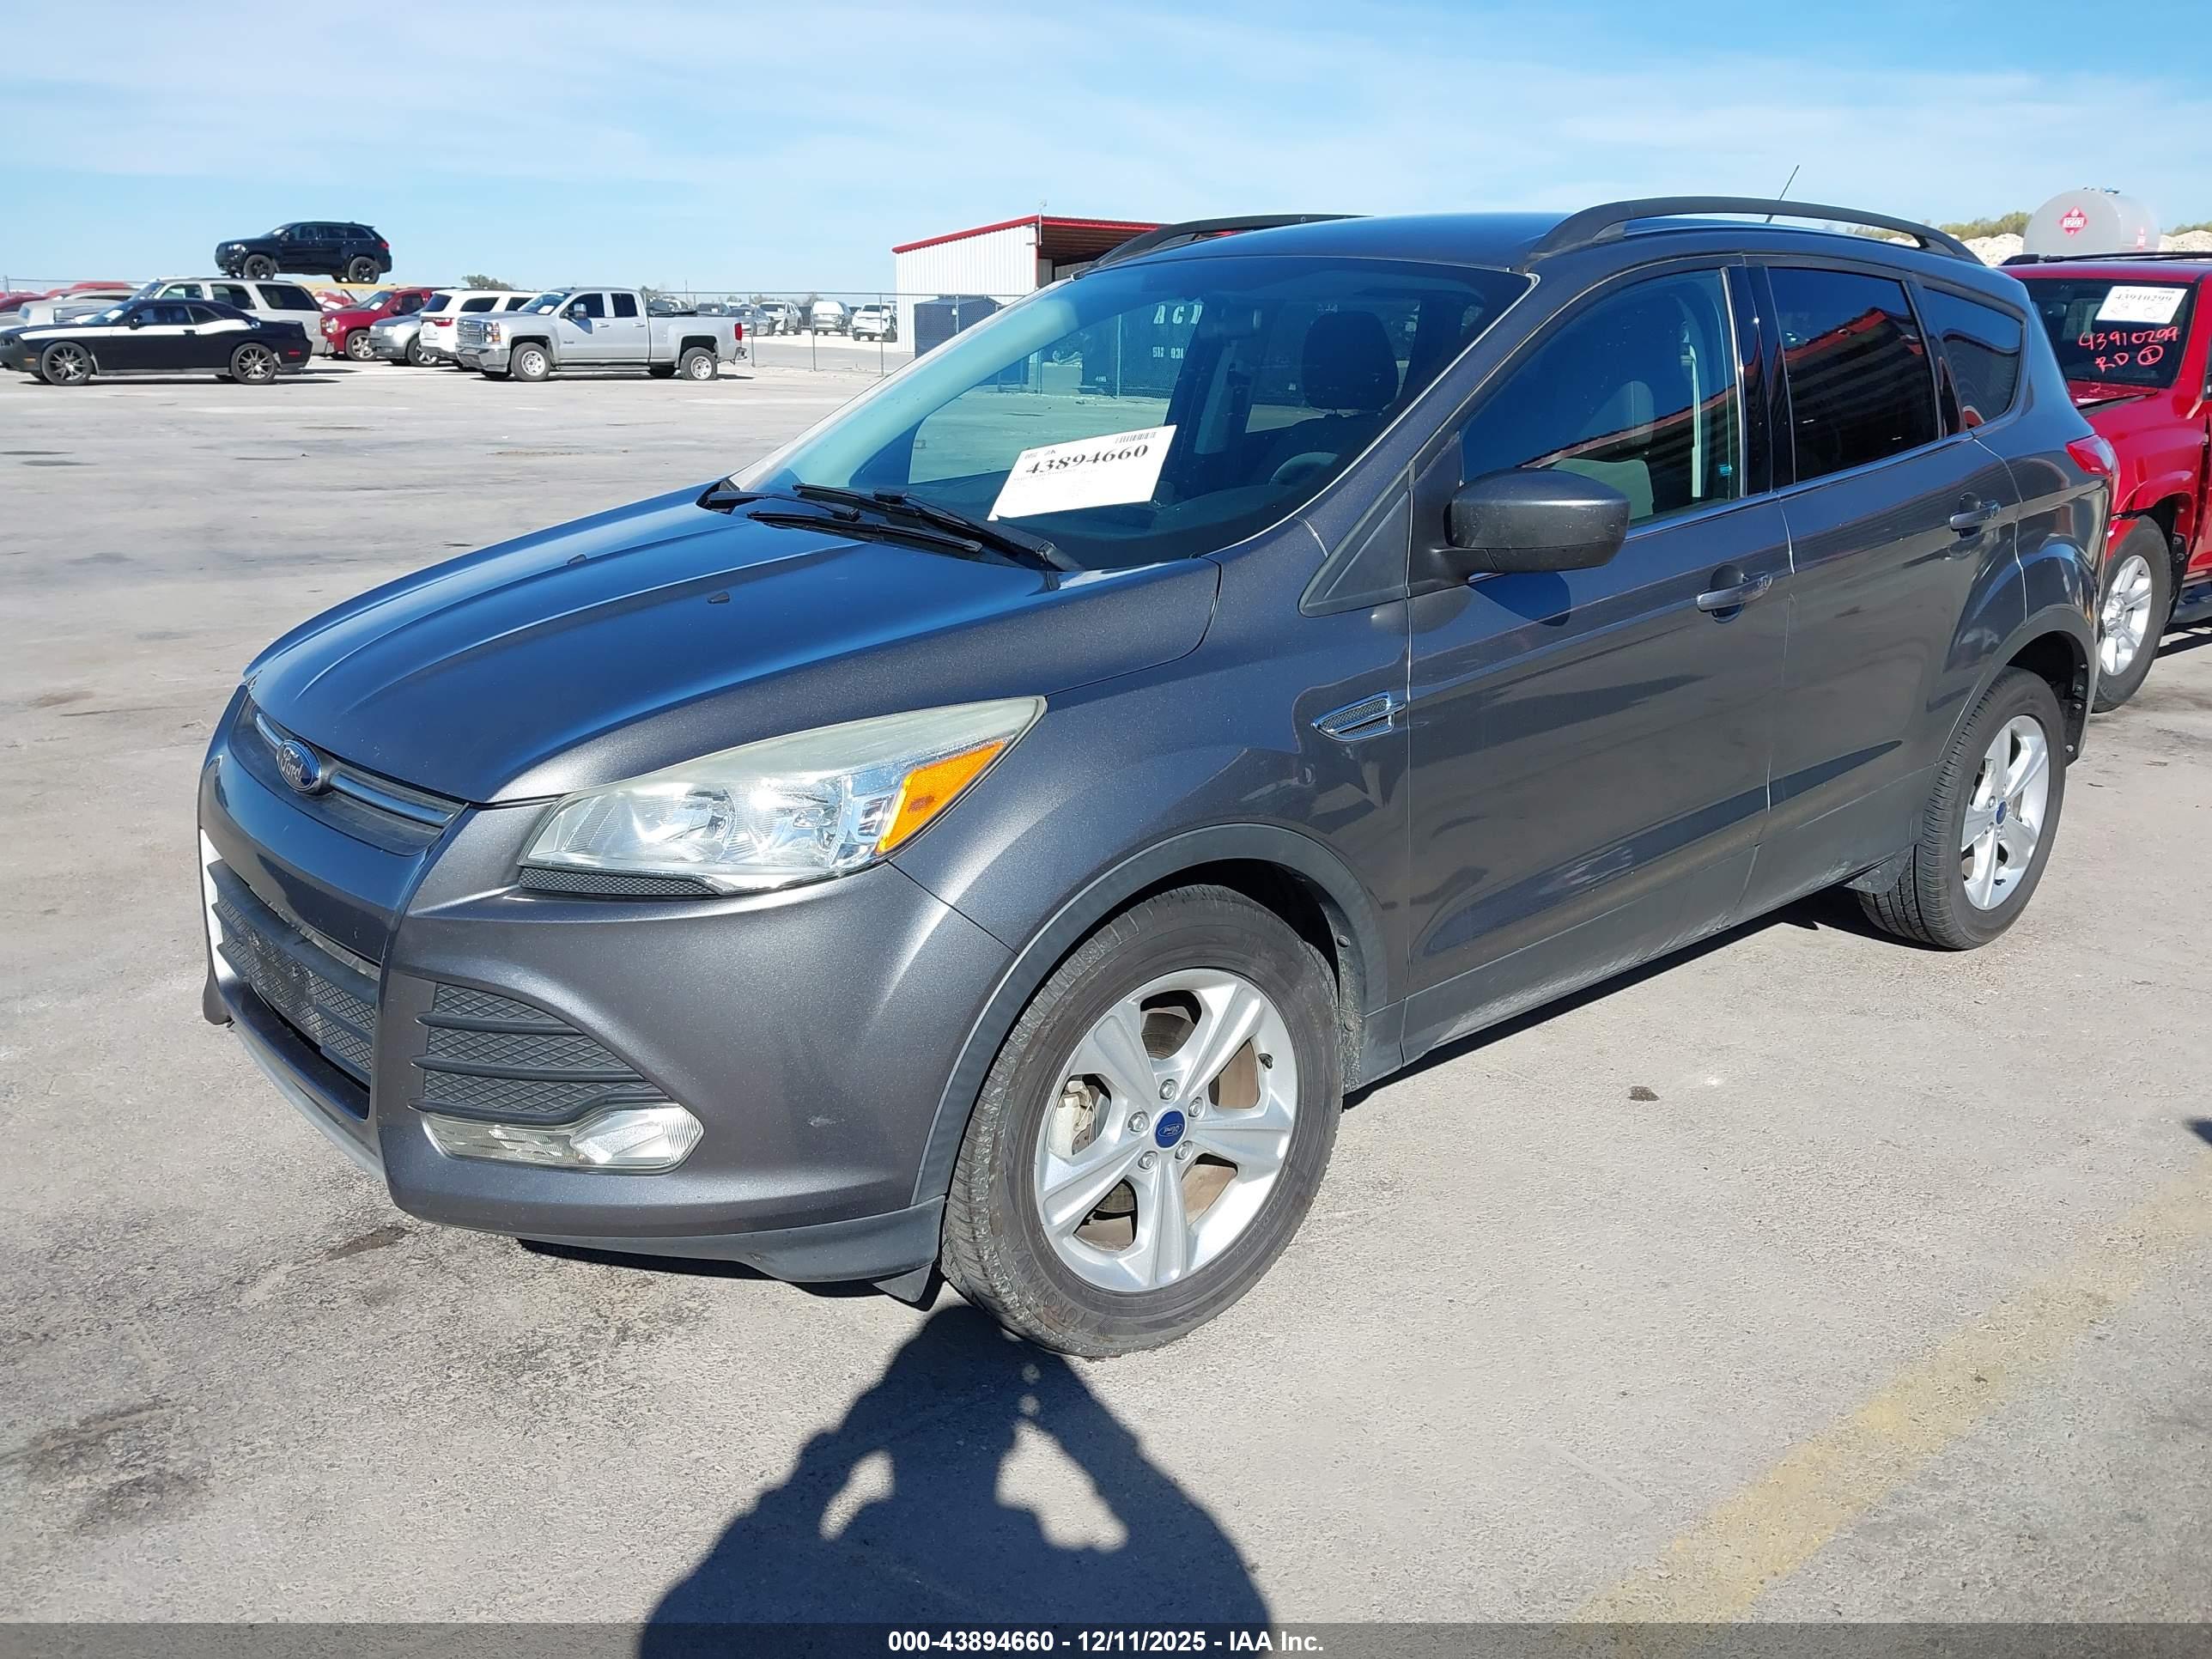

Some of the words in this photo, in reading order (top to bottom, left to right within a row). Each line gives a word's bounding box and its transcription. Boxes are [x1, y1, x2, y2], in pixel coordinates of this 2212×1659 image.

[2078, 326, 2179, 350] 43910299
[1025, 444, 1148, 474] 43894660
[281, 747, 304, 782] Ford
